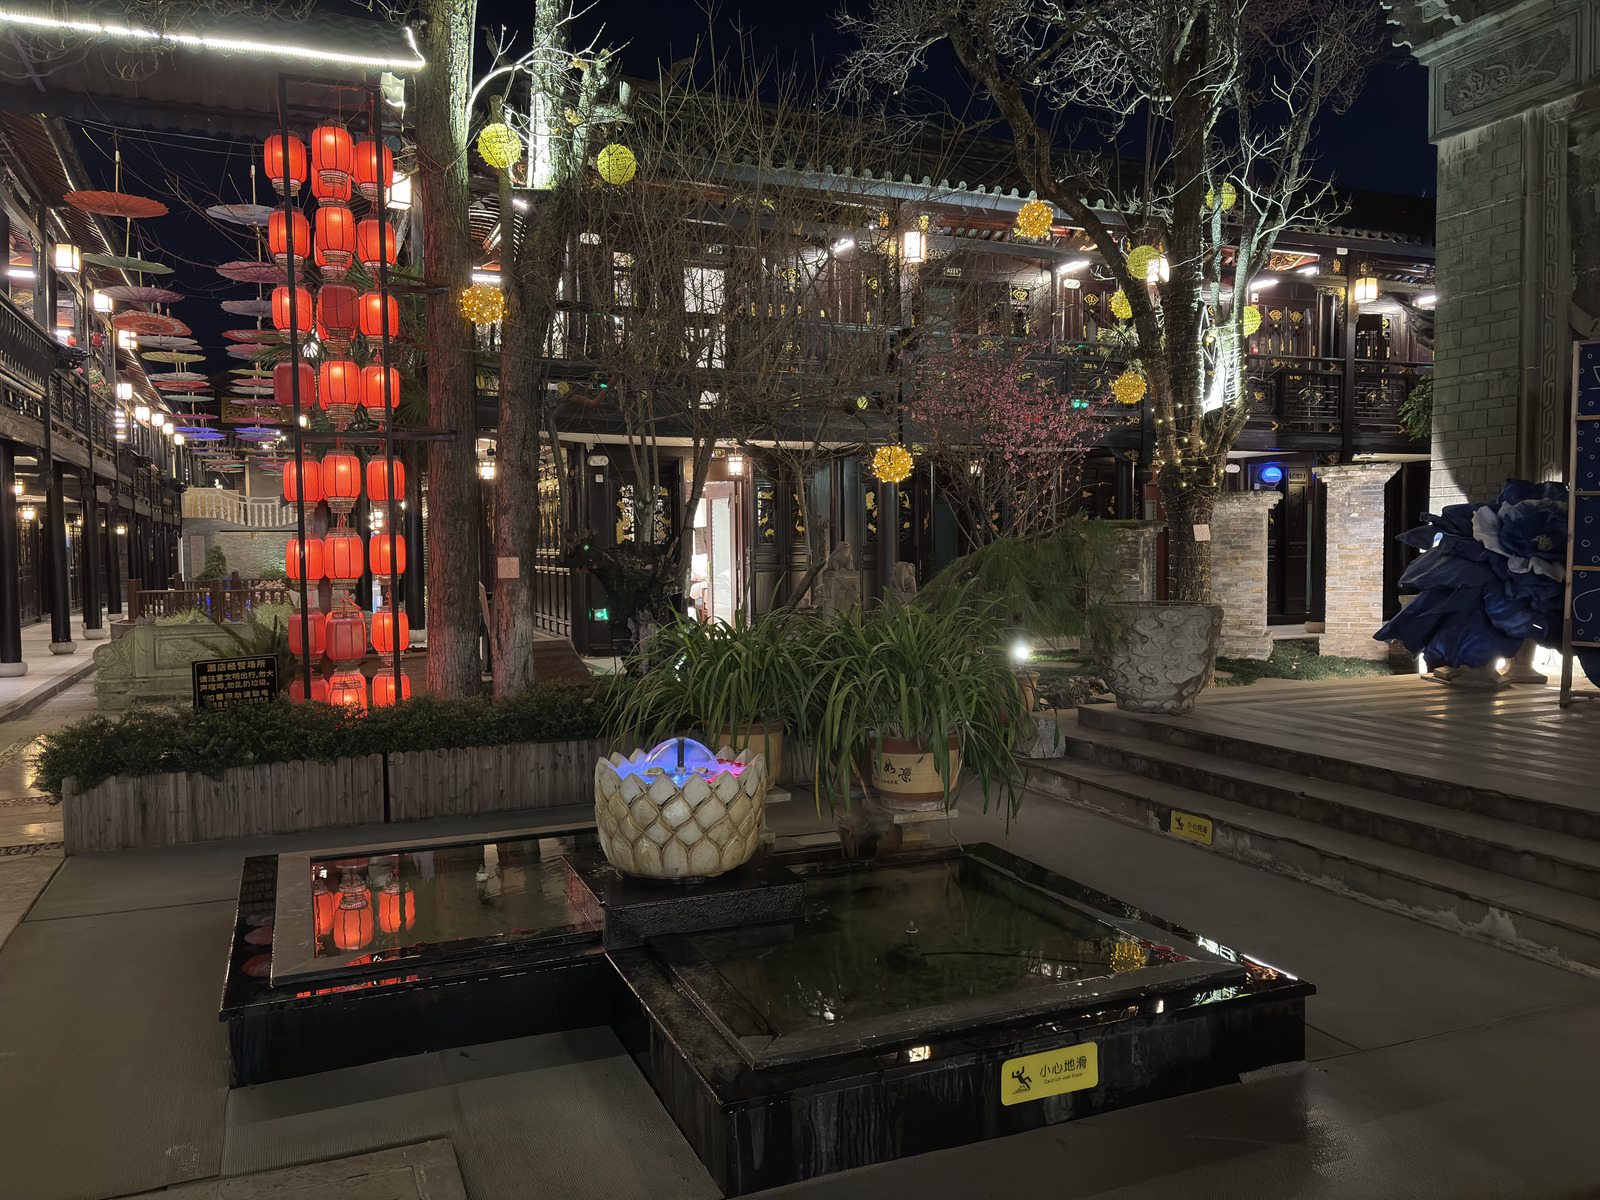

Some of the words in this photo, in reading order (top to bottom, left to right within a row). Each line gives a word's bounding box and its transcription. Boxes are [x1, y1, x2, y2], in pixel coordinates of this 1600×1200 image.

[207, 660, 266, 672] 酒店经营场所
[1040, 1056, 1087, 1077] 小心地滑
